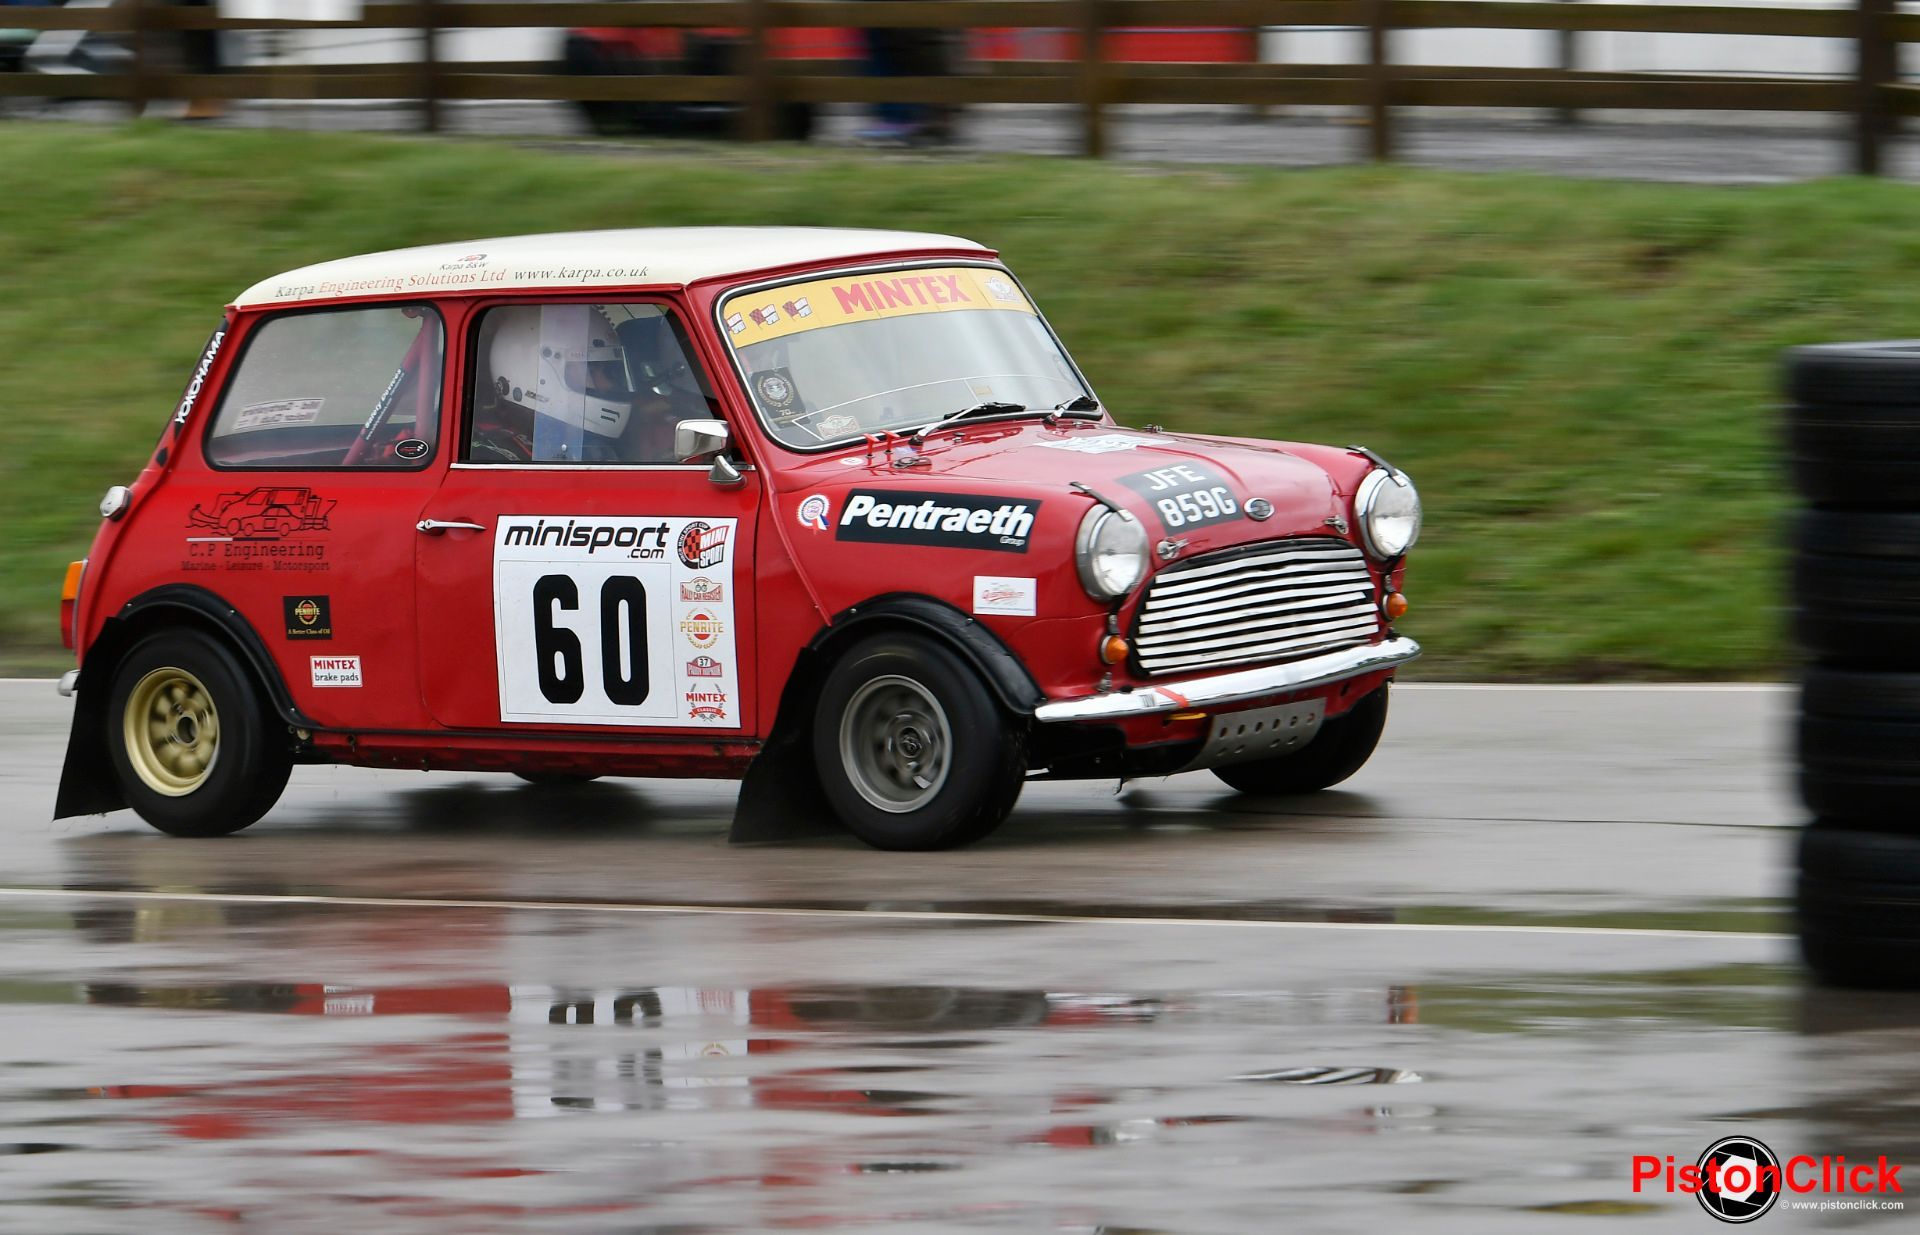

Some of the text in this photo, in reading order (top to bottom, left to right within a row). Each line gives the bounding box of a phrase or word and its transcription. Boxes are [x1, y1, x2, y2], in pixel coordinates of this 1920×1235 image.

[275, 265, 650, 300] Karpa Engineering Solutions Ltd www.karpa.co.uk
[832, 275, 973, 314] MINTEX
[174, 331, 226, 424] YOKOHAMA
[1144, 464, 1207, 491] JFE
[840, 495, 1034, 537] Pentraeth
[1157, 486, 1238, 527] 859G
[504, 519, 670, 554] minisport
[700, 526, 728, 549] MINI
[1000, 536, 1025, 547] Group
[190, 542, 325, 560] C.P Engineering
[627, 548, 665, 559] .com
[699, 544, 725, 568] SPORT
[181, 561, 216, 571] Marine
[273, 560, 330, 573] Motorsport
[680, 621, 724, 633] PENRITE
[533, 574, 649, 705] 60
[313, 659, 356, 670] MINTEX
[699, 658, 709, 666] 37
[315, 672, 359, 683] brake pads
[685, 692, 727, 702] MINTEX
